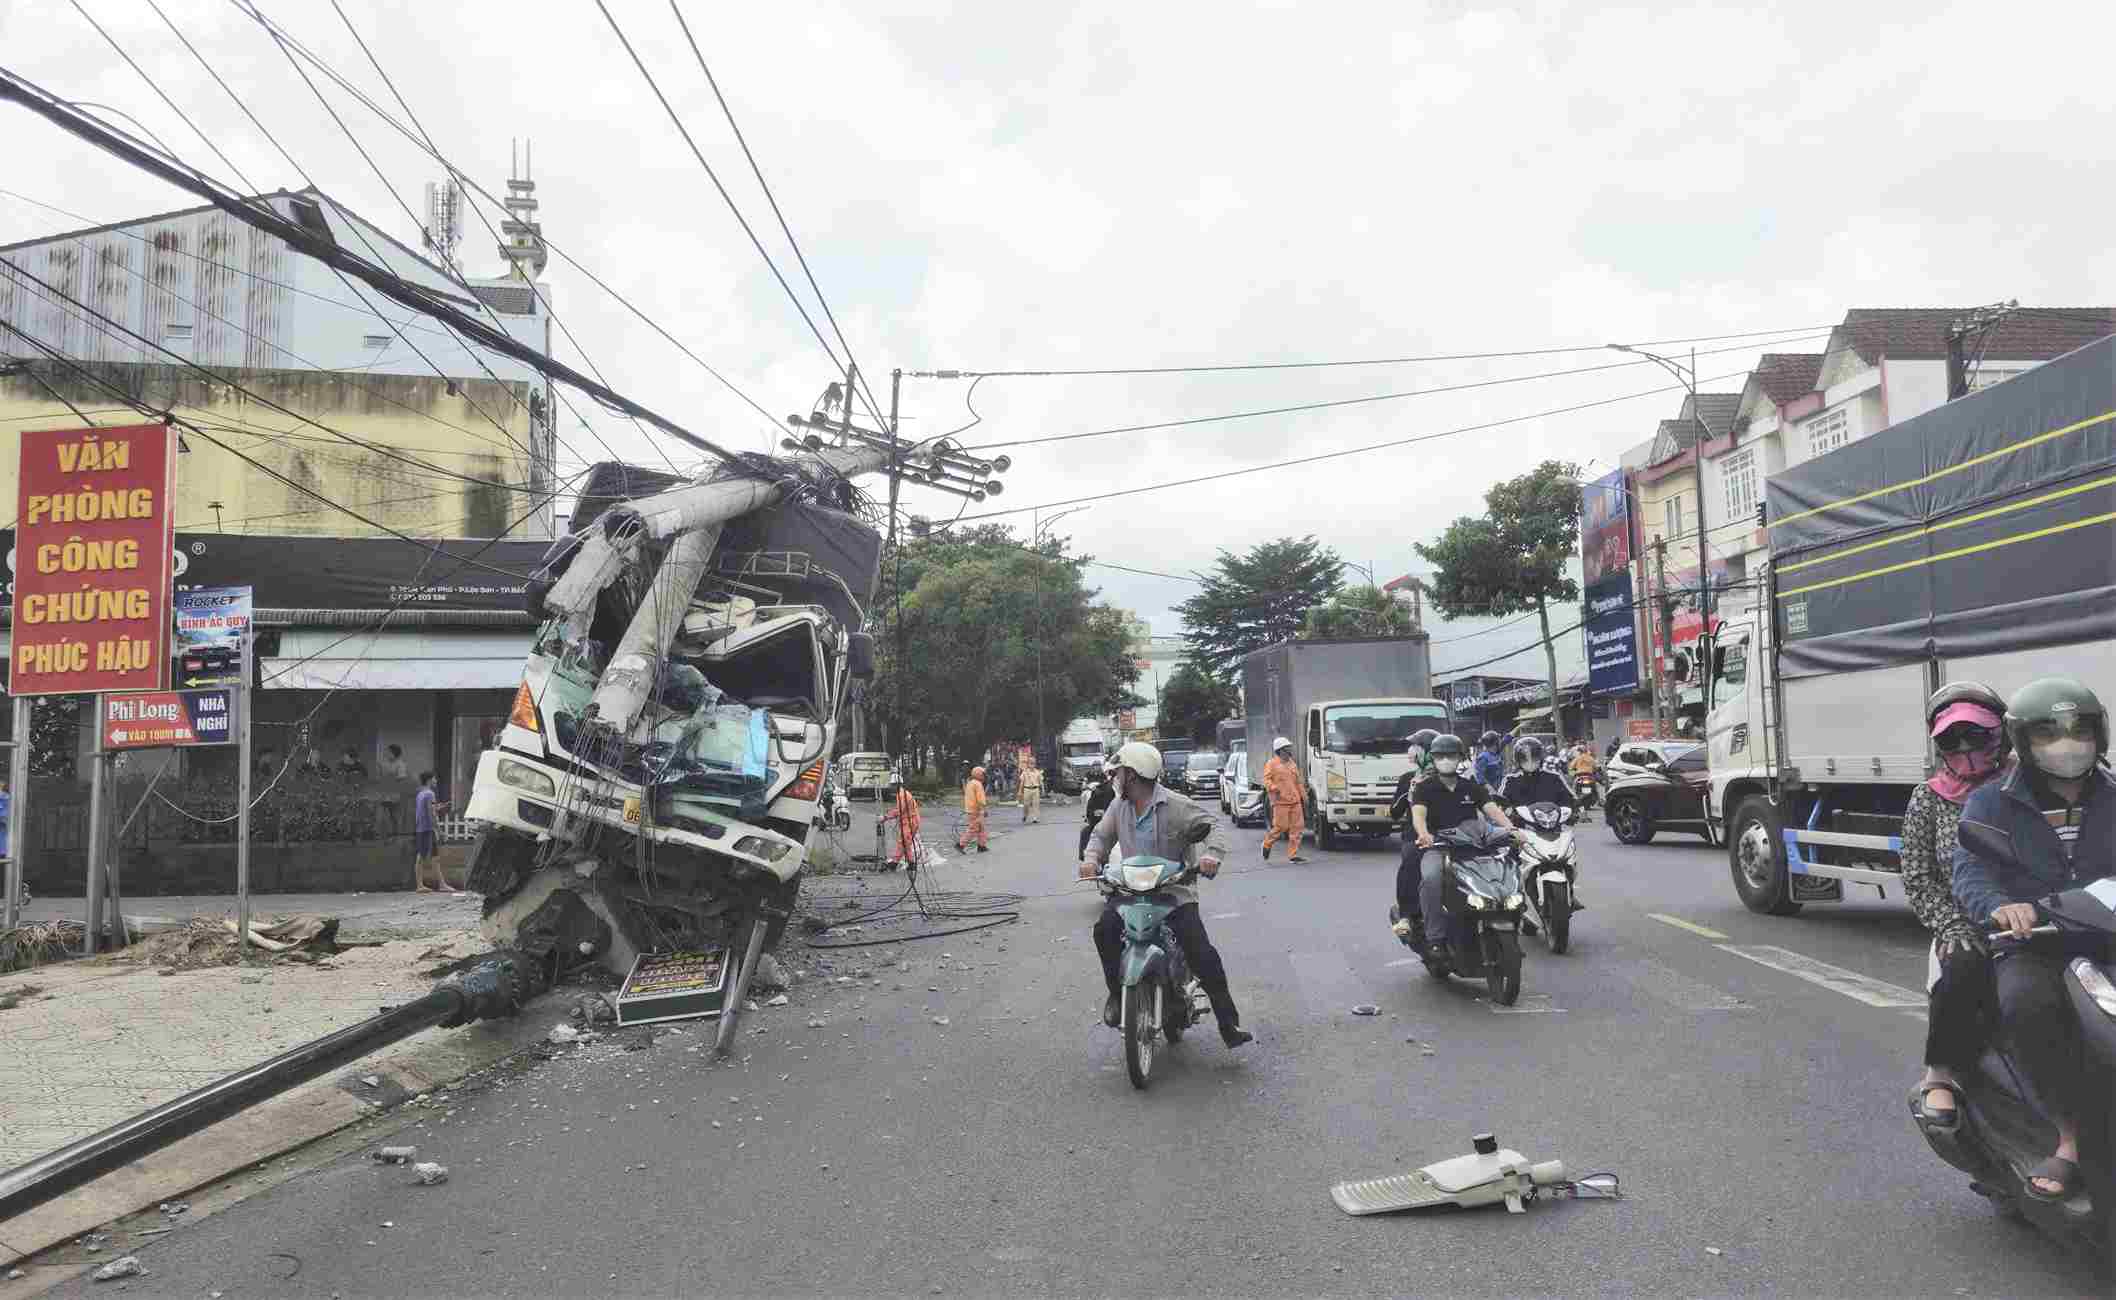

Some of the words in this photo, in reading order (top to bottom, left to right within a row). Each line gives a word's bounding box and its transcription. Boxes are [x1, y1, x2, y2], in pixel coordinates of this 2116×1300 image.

[57, 435, 130, 473] VĂN
[27, 484, 153, 525] PHÒNG
[37, 535, 139, 574] CÔNG
[22, 583, 151, 624] CHỨNG
[183, 595, 235, 609] ROCKET
[18, 636, 89, 674] PHÚC
[96, 634, 151, 676] HẬU
[108, 700, 135, 721] Phi
[139, 700, 178, 722] Long
